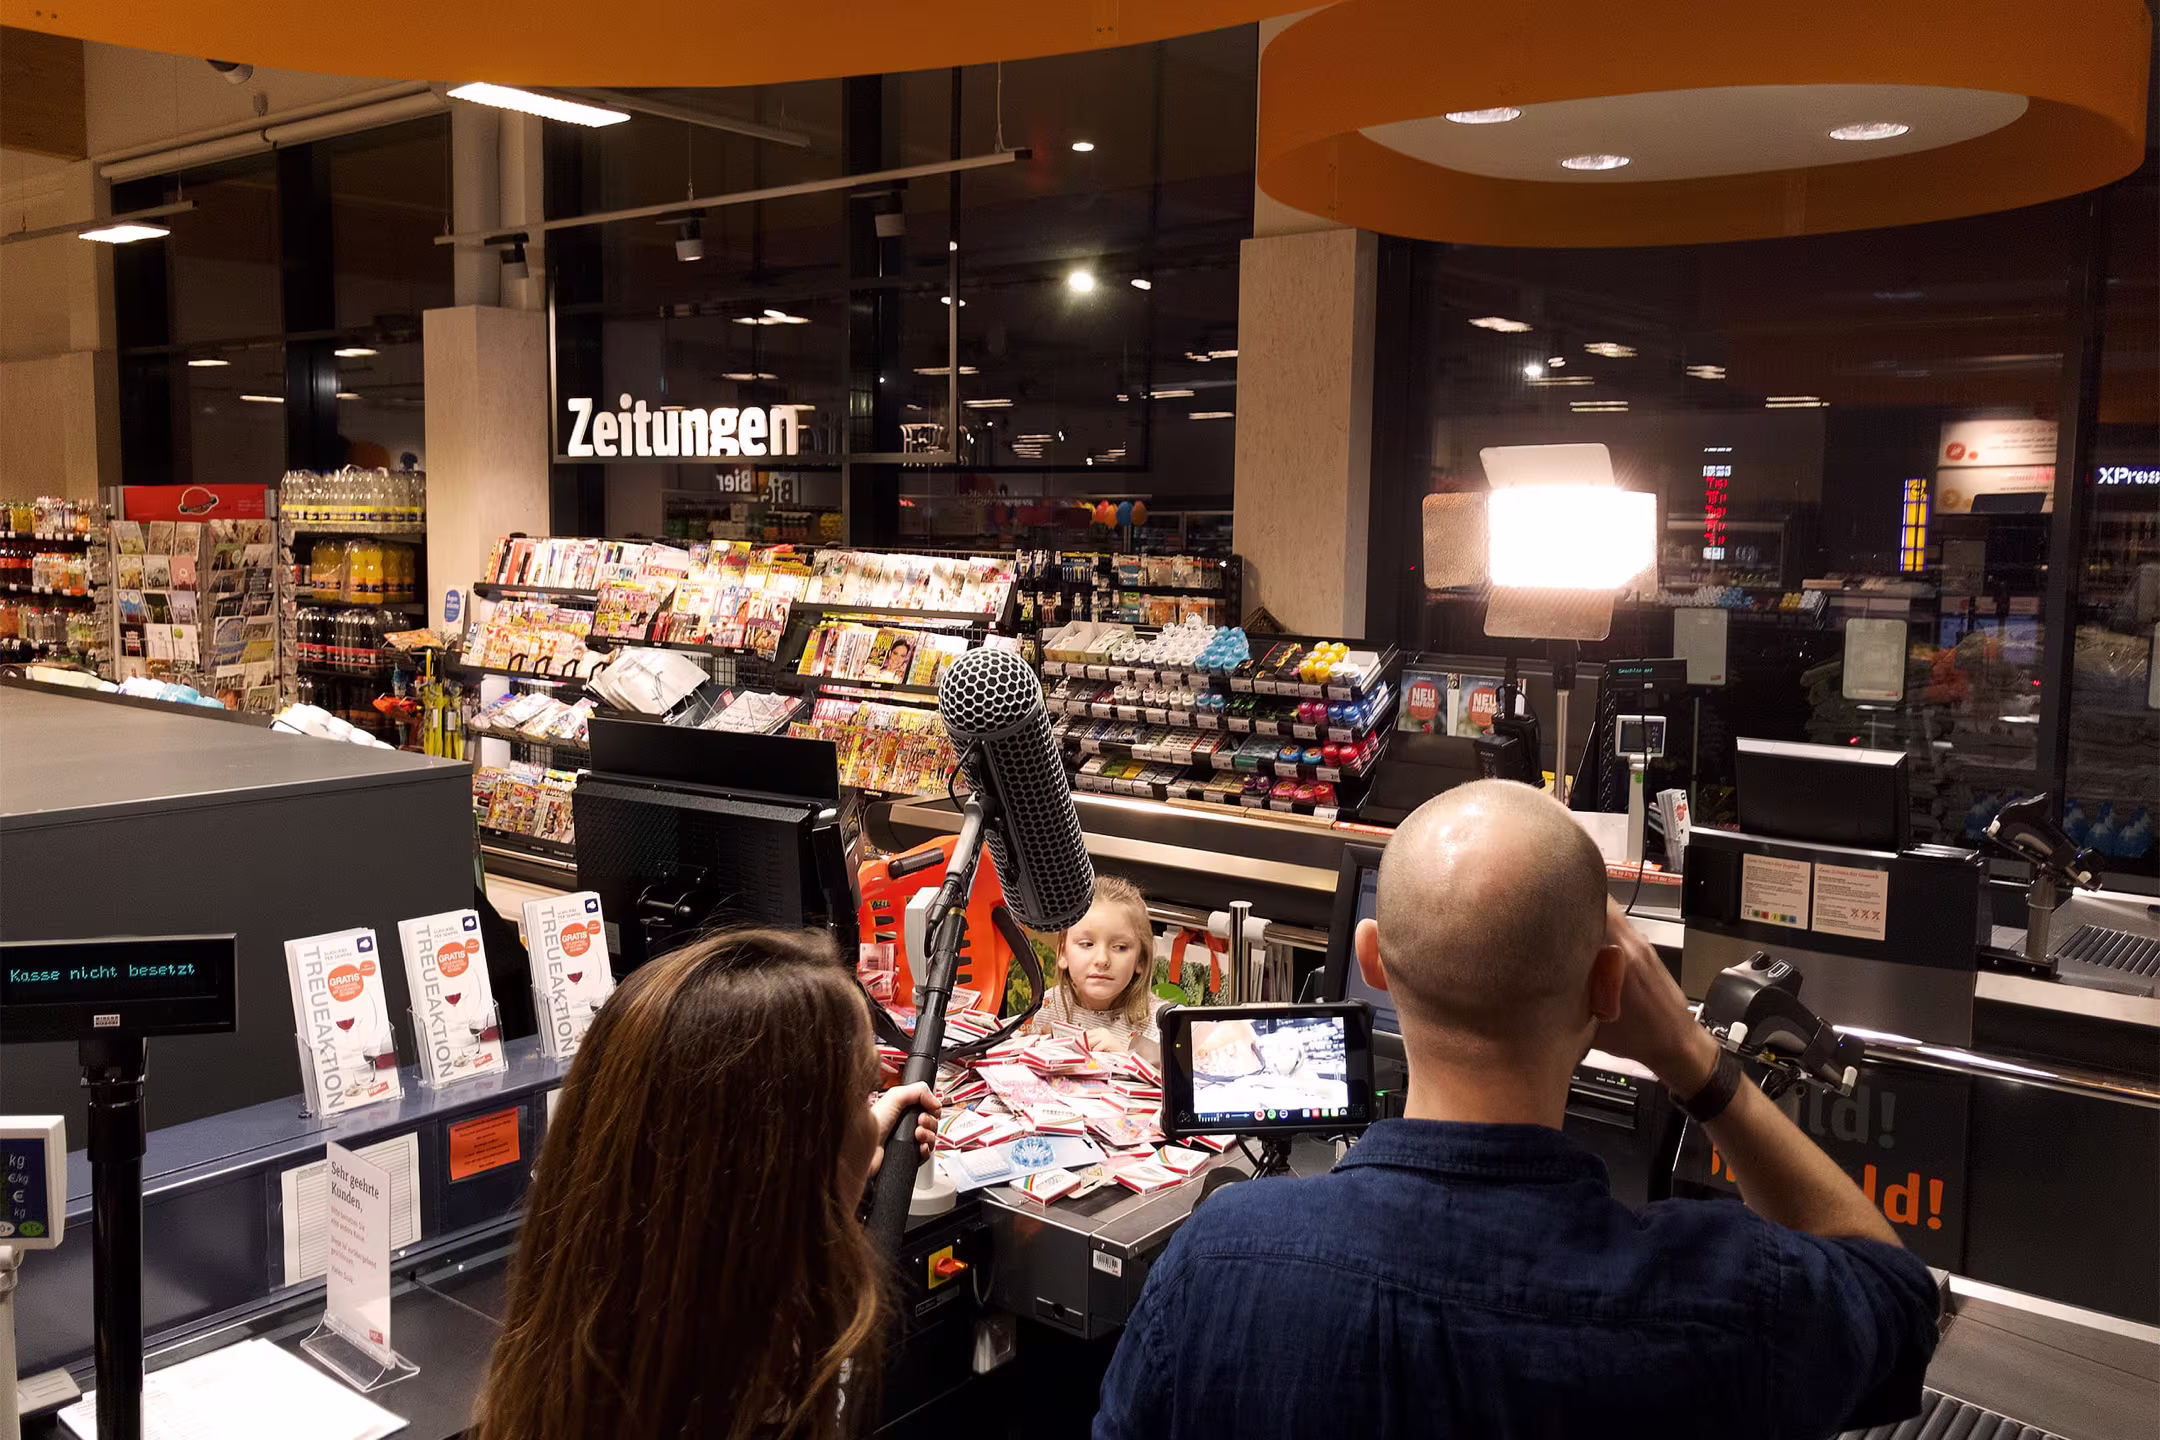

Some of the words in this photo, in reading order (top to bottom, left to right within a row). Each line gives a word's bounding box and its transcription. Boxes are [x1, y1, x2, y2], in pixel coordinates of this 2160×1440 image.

[567, 392, 799, 457] Zeitungen
[1412, 687, 1436, 702] NEU
[1473, 692, 1497, 706] NEU
[561, 931, 588, 943] GRATIS
[438, 950, 466, 963] GRATIS
[10, 969, 61, 983] Kasse
[70, 965, 118, 980] nicht
[129, 963, 195, 978] besetzt
[329, 972, 360, 986] GRATIS
[541, 906, 575, 1052] TREUEAKTION
[416, 924, 454, 1078] TREUEAKTION
[303, 945, 346, 1109] TREUEAKTION
[9, 1154, 25, 1169] kg
[8, 1173, 29, 1186] €/kg
[331, 1161, 349, 1181] Sehr
[350, 1174, 379, 1200] geehrte
[13, 1190, 24, 1203] €
[331, 1181, 363, 1213] Kunden,
[14, 1208, 26, 1219] kg
